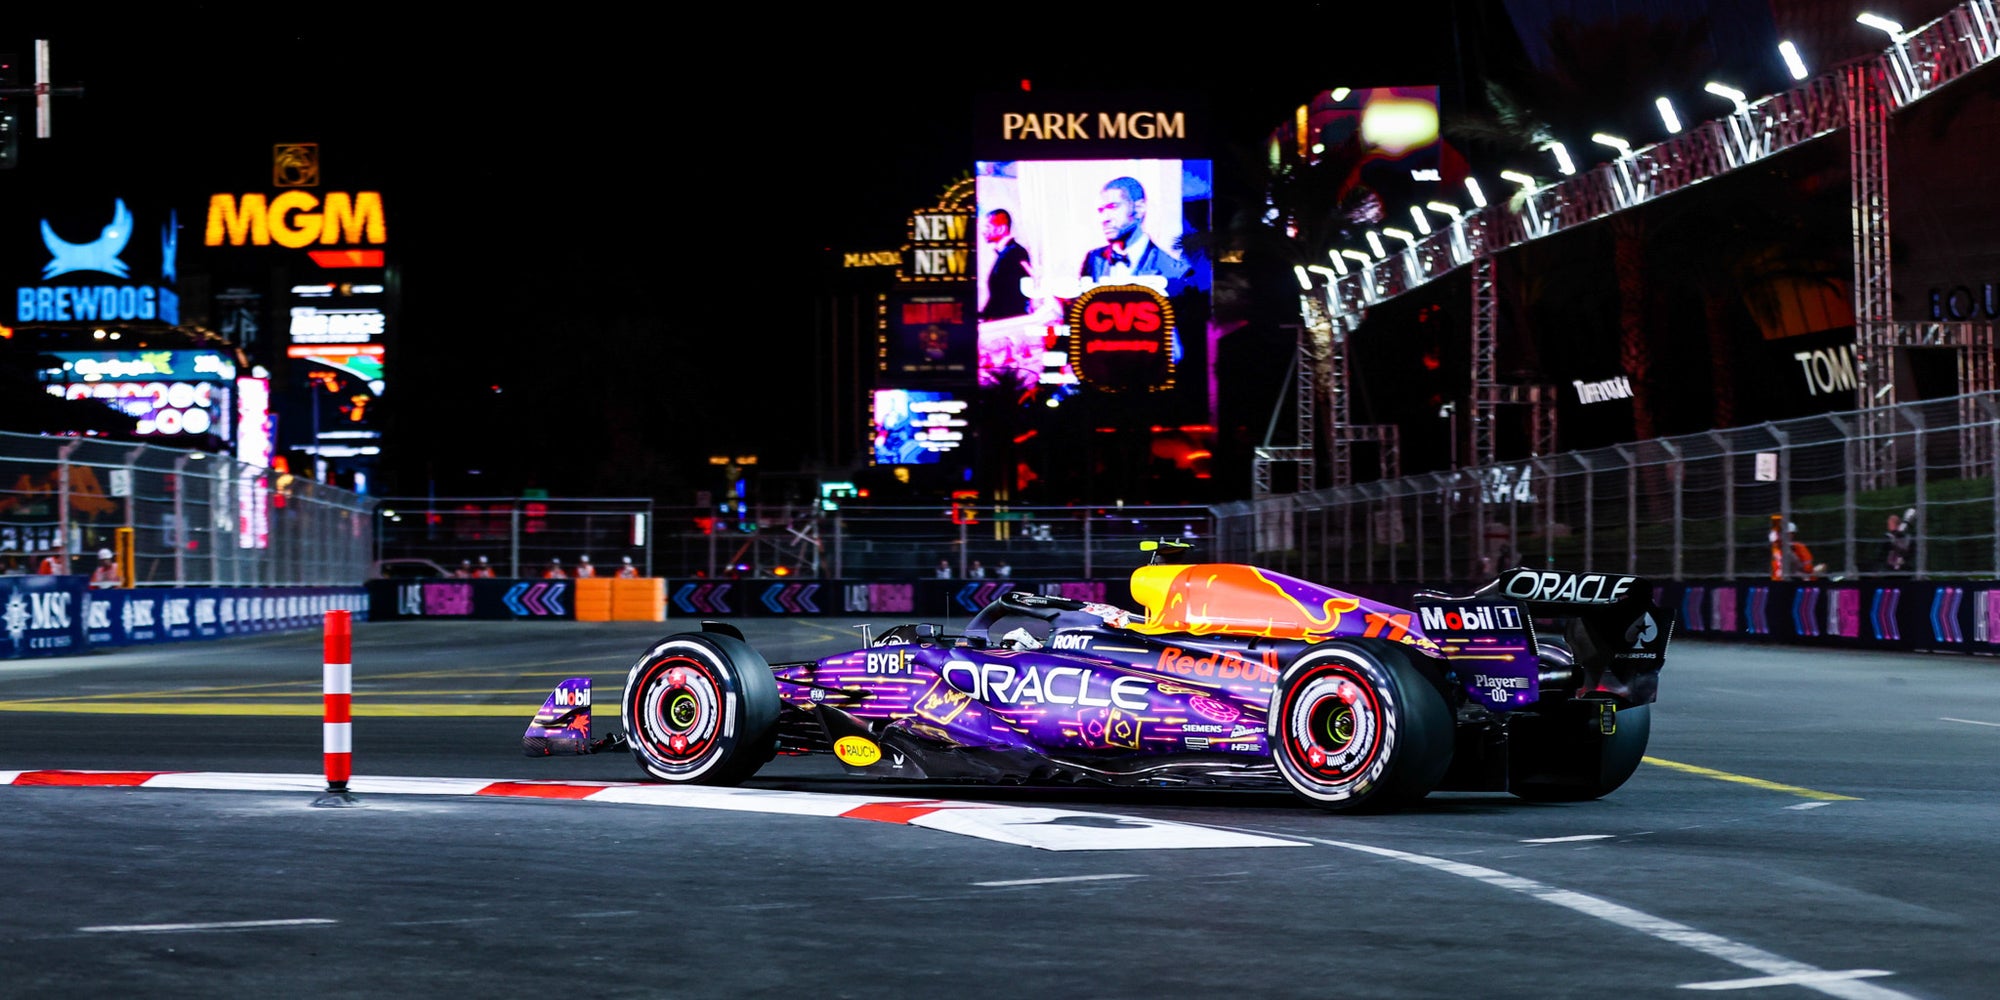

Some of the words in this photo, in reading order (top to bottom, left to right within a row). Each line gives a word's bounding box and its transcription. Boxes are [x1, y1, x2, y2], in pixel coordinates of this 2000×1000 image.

[1002, 112, 1090, 140] PARK
[1098, 111, 1186, 139] MGM
[204, 190, 387, 249] MGM
[913, 214, 967, 241] NEW
[913, 248, 967, 275] NEW
[16, 285, 156, 322] BREWDOG
[1084, 301, 1162, 332] CVS
[1506, 570, 1637, 602] ORACLE
[1362, 612, 1412, 641] 11
[1420, 606, 1495, 631] Mobil
[1053, 634, 1093, 650] ROKT
[1156, 646, 1220, 676] Red
[1218, 651, 1279, 683] Bull
[942, 660, 1156, 710] ORACLE
[1474, 674, 1516, 690] Player
[555, 688, 591, 706] Mobil
[1182, 724, 1223, 733] SIEMENS
[846, 744, 875, 758] RAUCH
